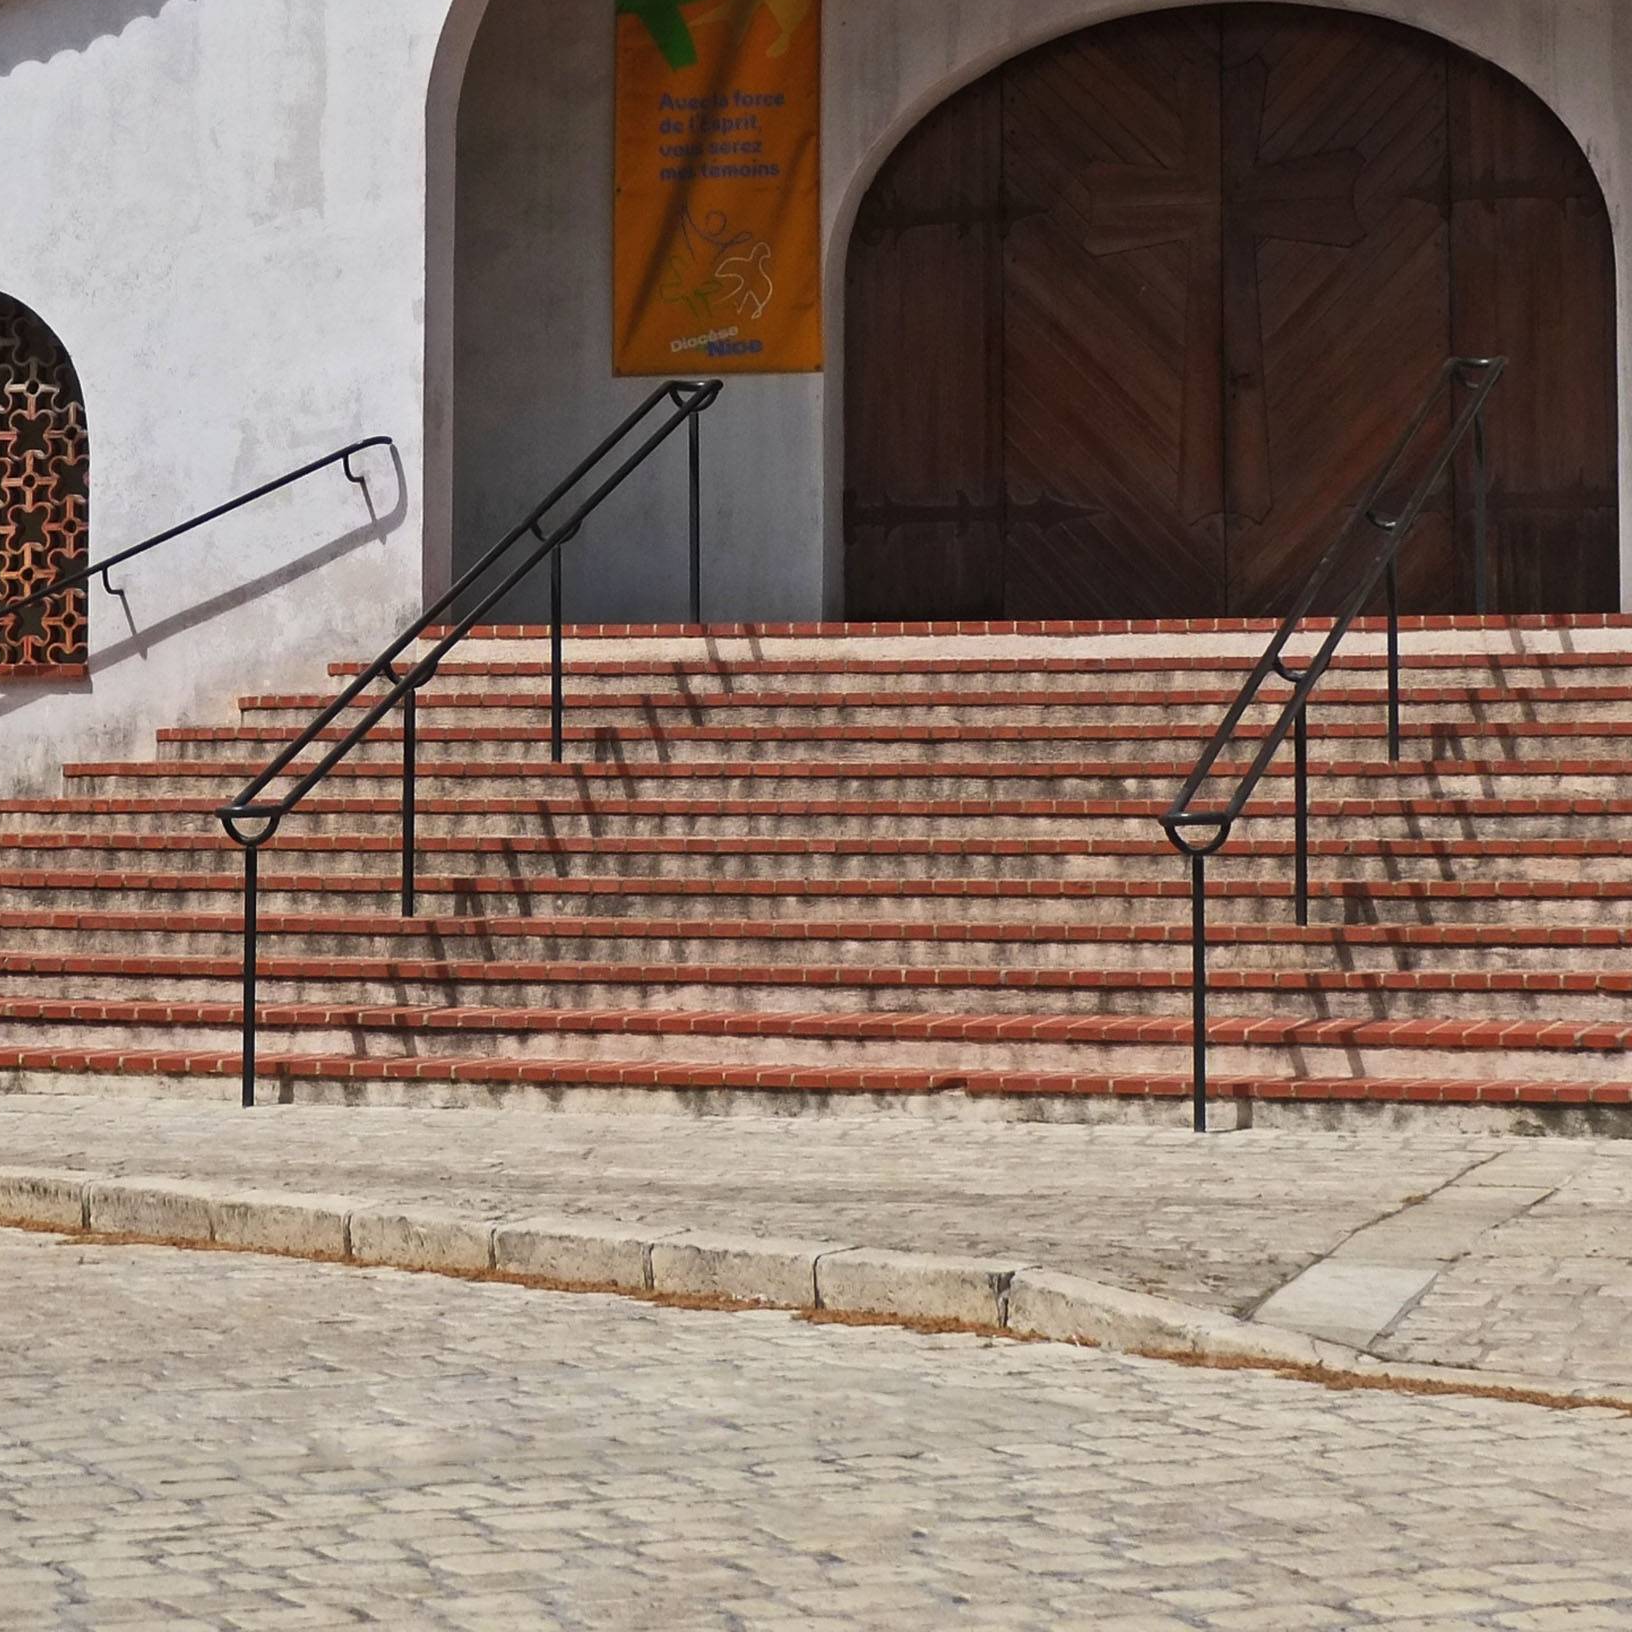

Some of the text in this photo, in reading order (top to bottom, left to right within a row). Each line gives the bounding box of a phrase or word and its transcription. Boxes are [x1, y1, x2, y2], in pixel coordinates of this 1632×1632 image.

[732, 89, 785, 108] force
[659, 117, 683, 134] de
[708, 140, 762, 155] serez
